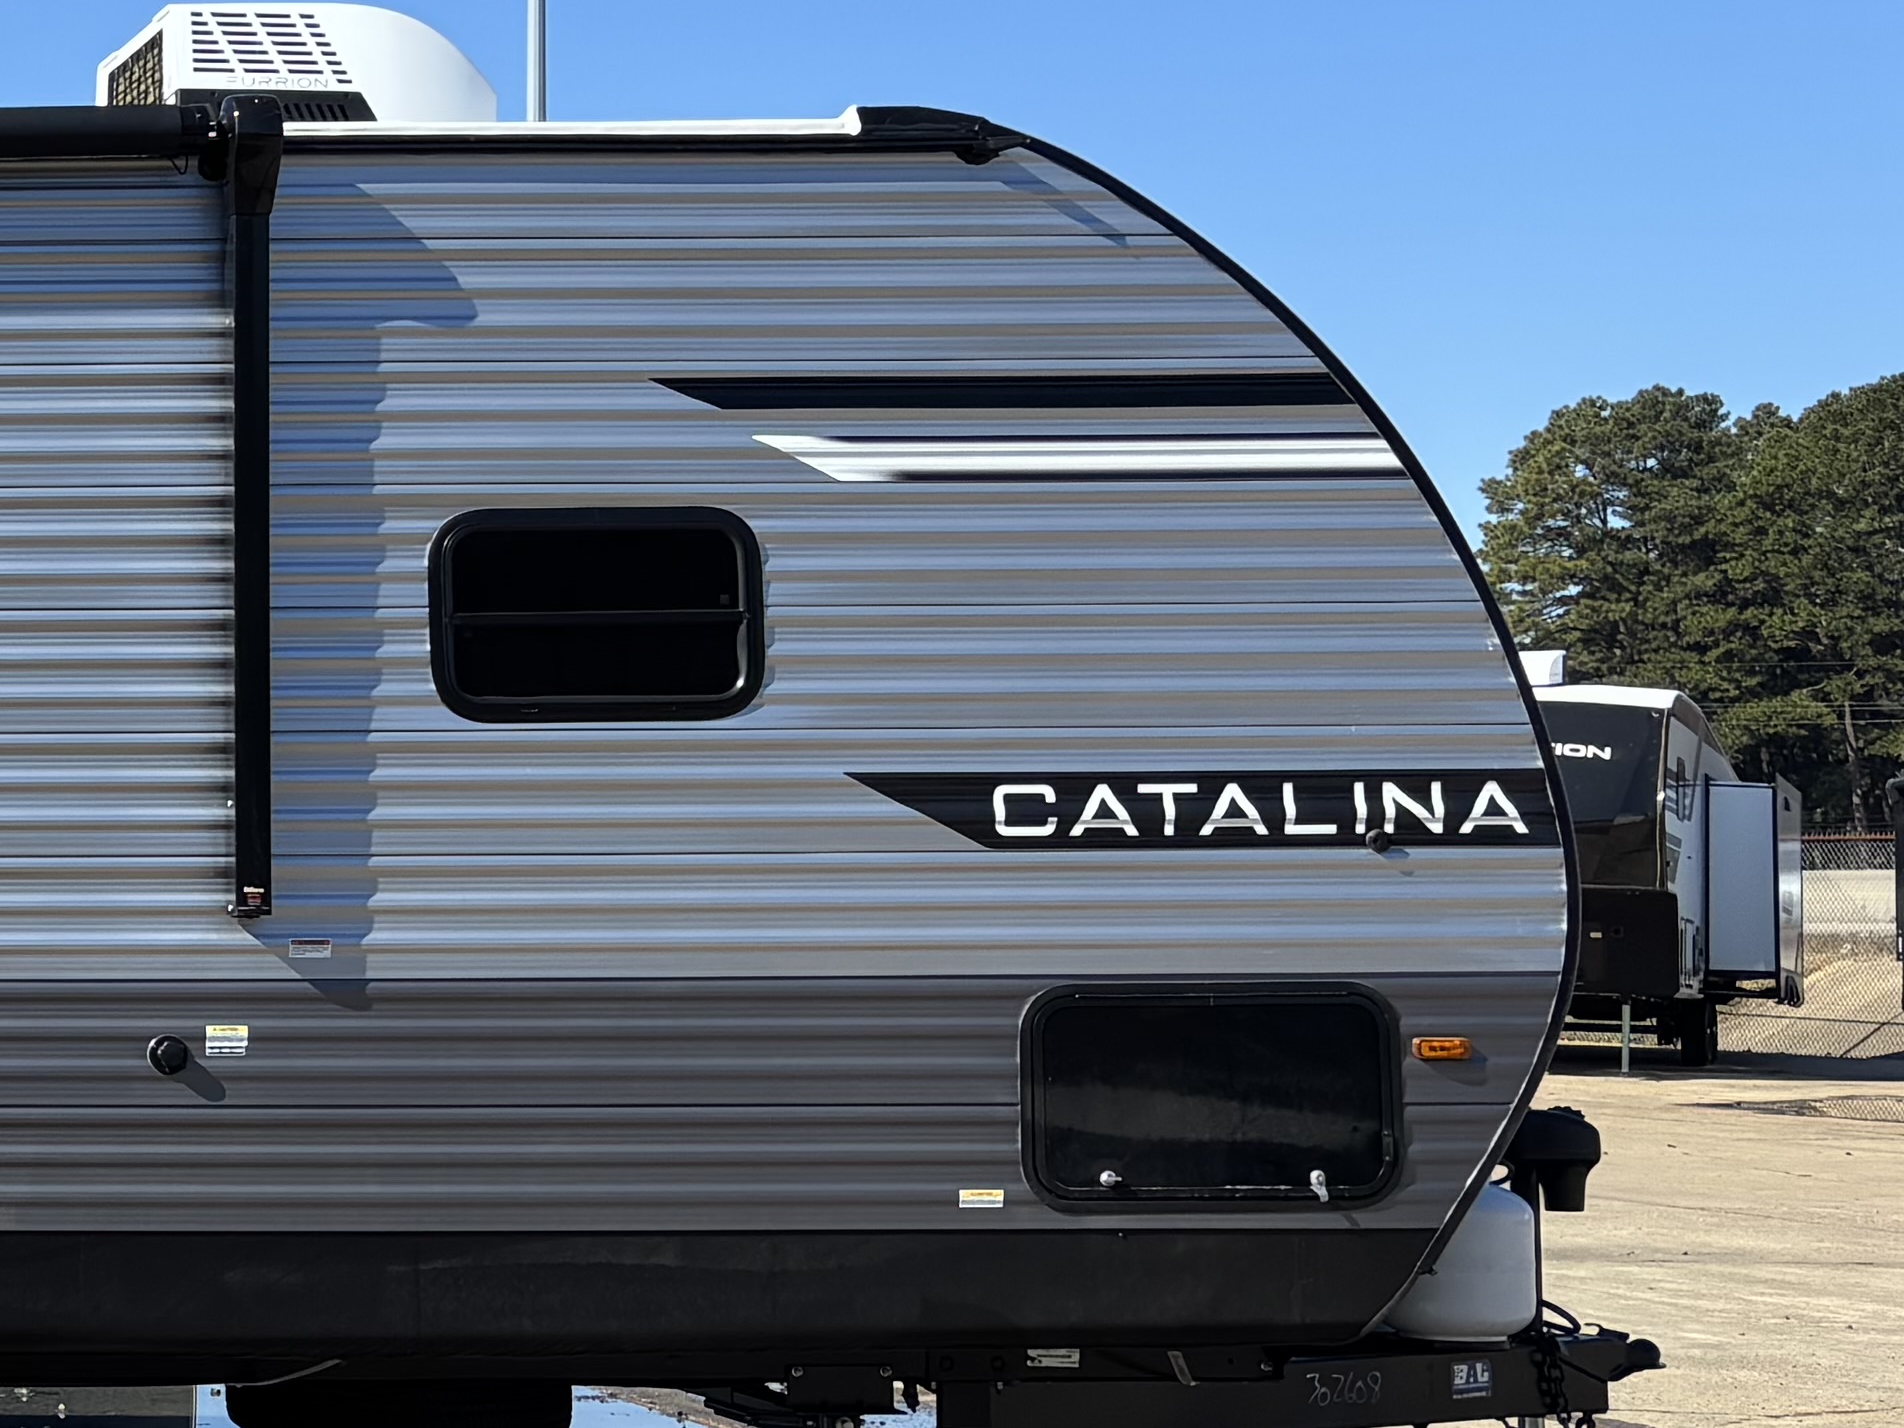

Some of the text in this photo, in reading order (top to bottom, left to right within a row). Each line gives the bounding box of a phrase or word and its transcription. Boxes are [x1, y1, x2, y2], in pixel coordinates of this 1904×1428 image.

[224, 76, 329, 89] FURRION
[1550, 741, 1612, 761] ION
[991, 780, 1530, 838] CATALINA
